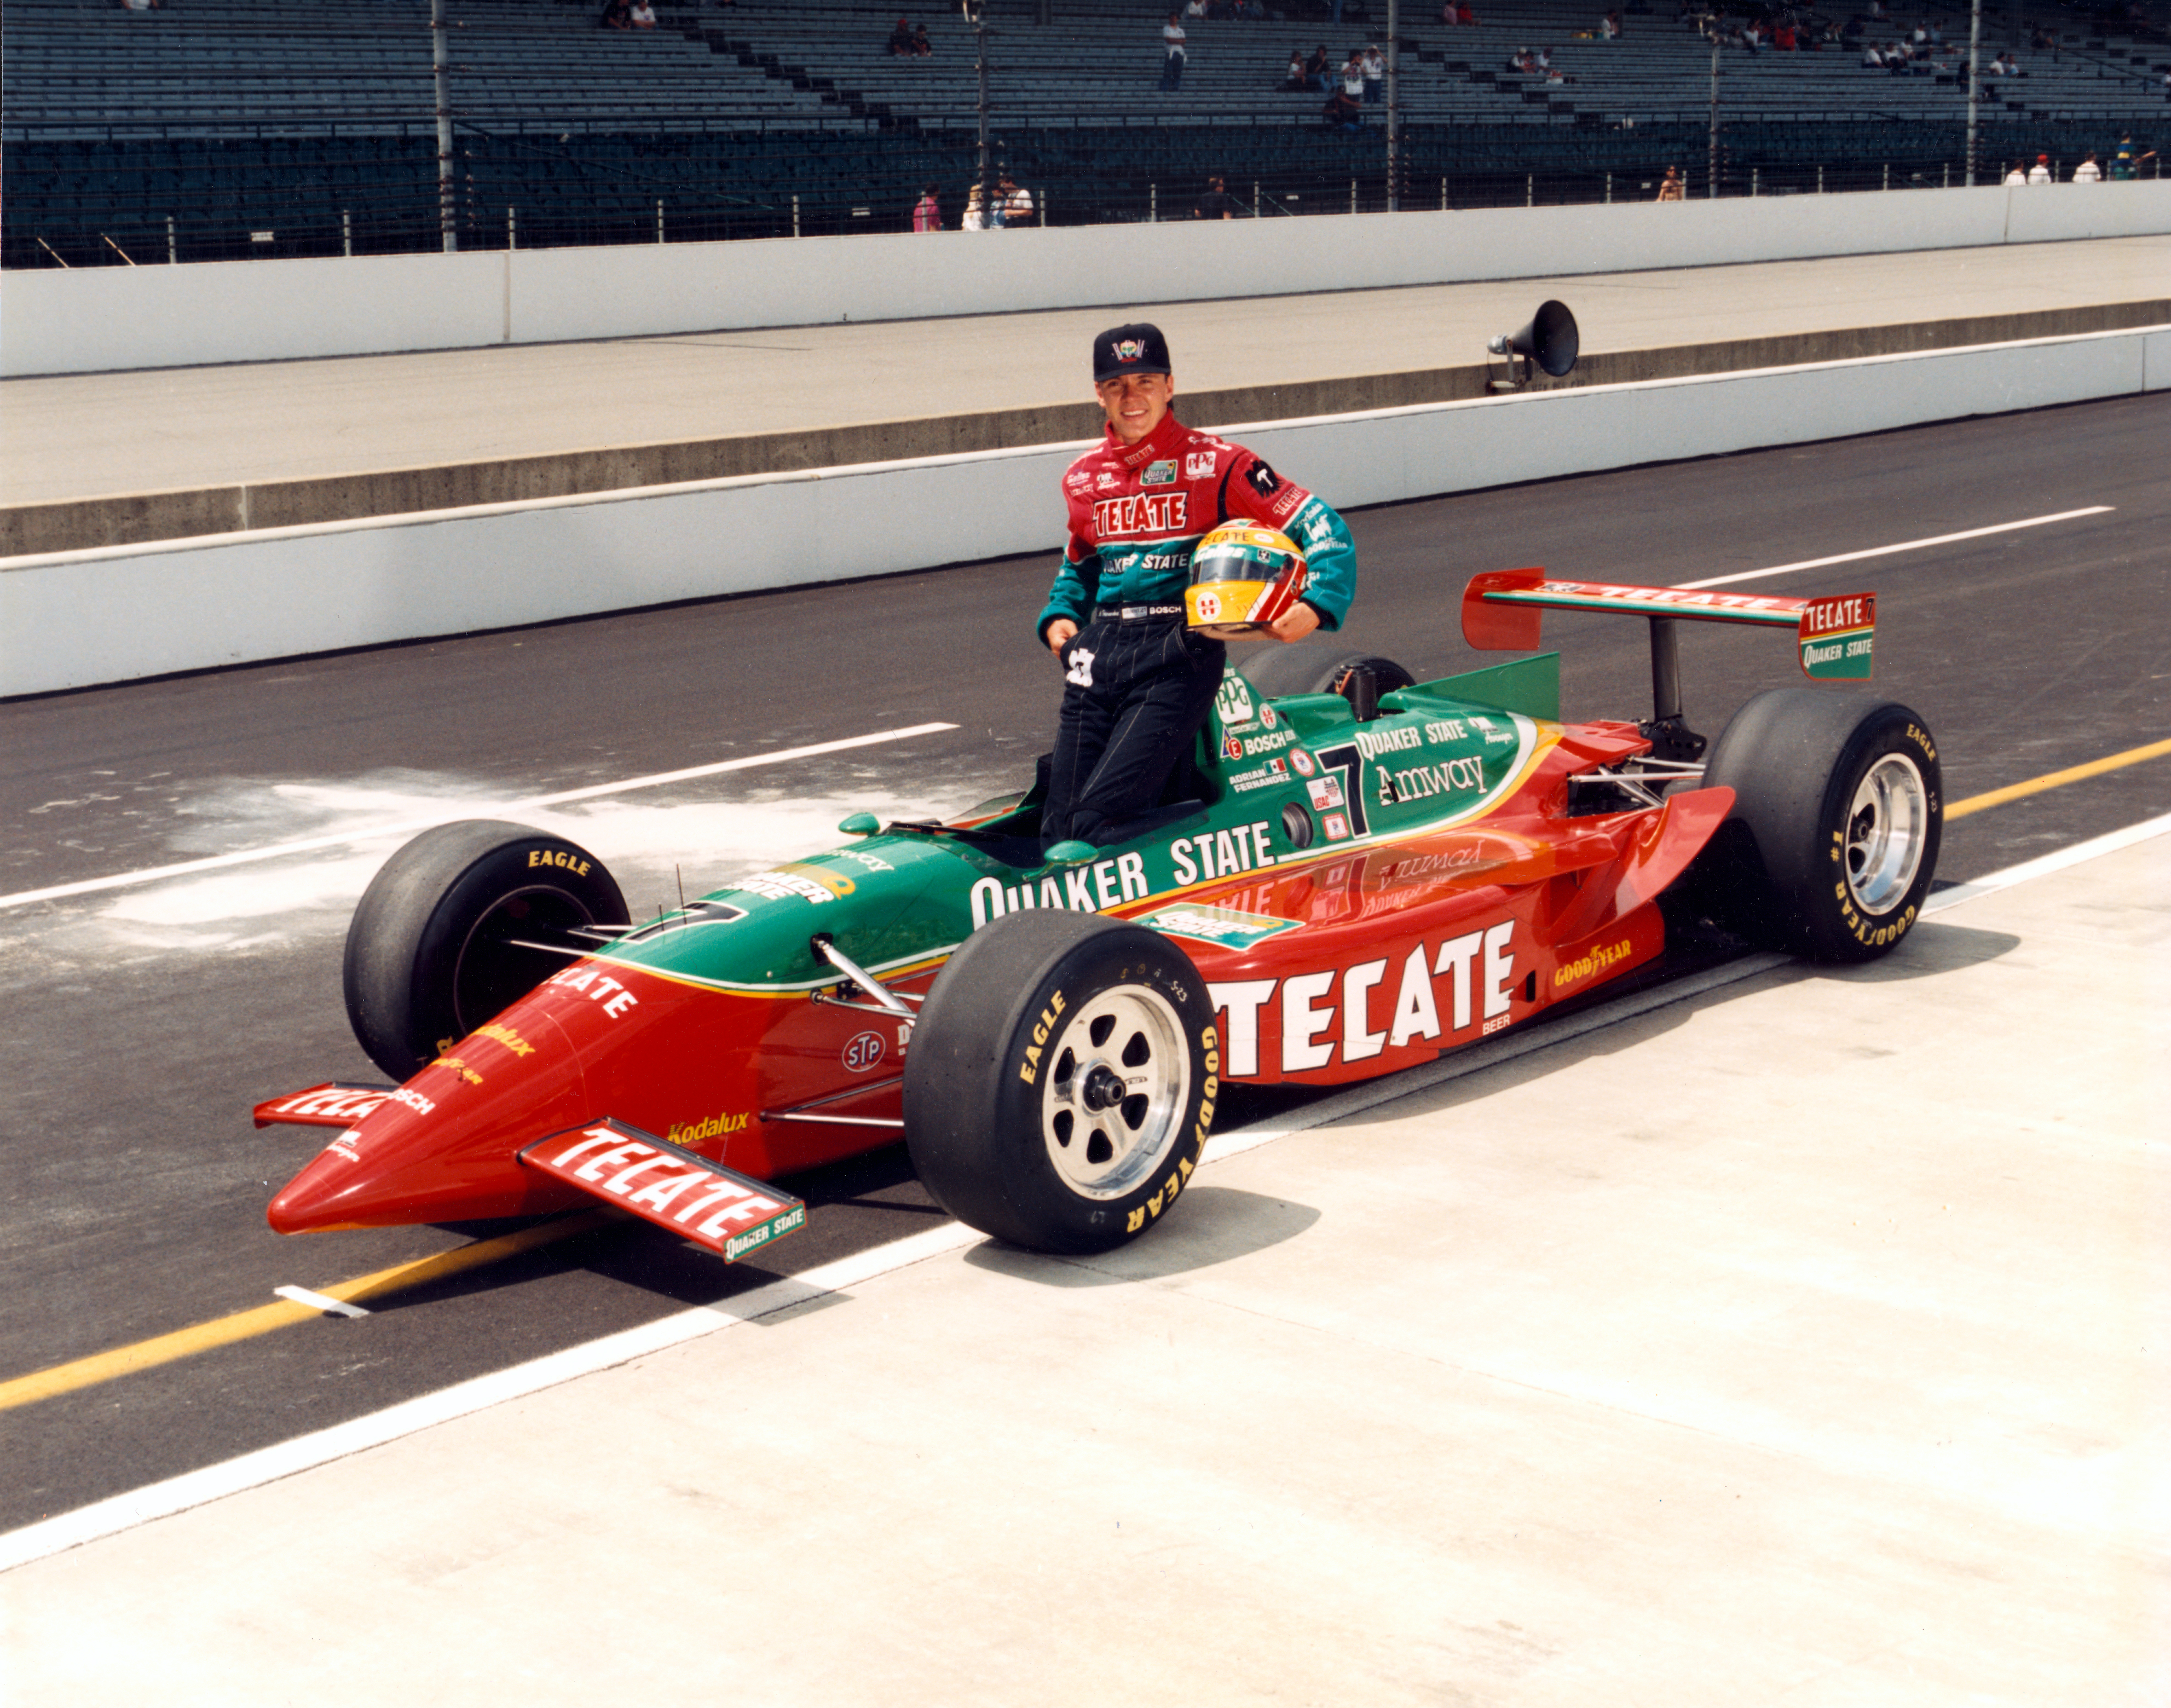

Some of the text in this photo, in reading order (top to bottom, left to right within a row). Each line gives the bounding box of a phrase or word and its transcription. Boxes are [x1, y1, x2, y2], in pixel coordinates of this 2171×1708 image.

[1125, 445, 1154, 464] TECATE
[1188, 454, 1213, 469] PPG
[1144, 469, 1173, 480] QUAKER
[1146, 476, 1167, 484] STATE
[1094, 492, 1188, 536] TECATE
[1273, 487, 1302, 515] TECATE
[1141, 553, 1189, 570] STATE
[1194, 544, 1246, 563] Galles
[1150, 606, 1181, 614] BOSCH
[1600, 586, 1775, 610] TECATE
[1806, 597, 1874, 631] TECATE 7
[1804, 639, 1873, 669] QUAKER STATE
[1216, 680, 1249, 714] PPG
[1244, 731, 1286, 755] BOSCH
[1355, 726, 1422, 762] QUAKER
[1425, 720, 1468, 745] STATE
[1906, 724, 1936, 762] EAGLE
[1229, 769, 1266, 784] ADRIAN
[1234, 772, 1292, 793] FERNANDEZ
[1313, 740, 1364, 841] 7
[1376, 755, 1488, 807] Amway
[1314, 795, 1330, 809] USAC
[528, 851, 592, 876] EAGLE
[969, 821, 1275, 932] QUAKER STATE
[1152, 911, 1267, 934] QUAKER
[1555, 939, 1631, 986] GOODYEAR
[1203, 918, 1516, 1077] TECATE
[1020, 990, 1066, 1086] EAGLE
[1482, 1014, 1510, 1036] BEER
[848, 1034, 880, 1065] STP
[668, 1112, 750, 1144] Kodalux
[551, 1128, 781, 1239] TECATE
[726, 1209, 804, 1260] QUAKER STATE
